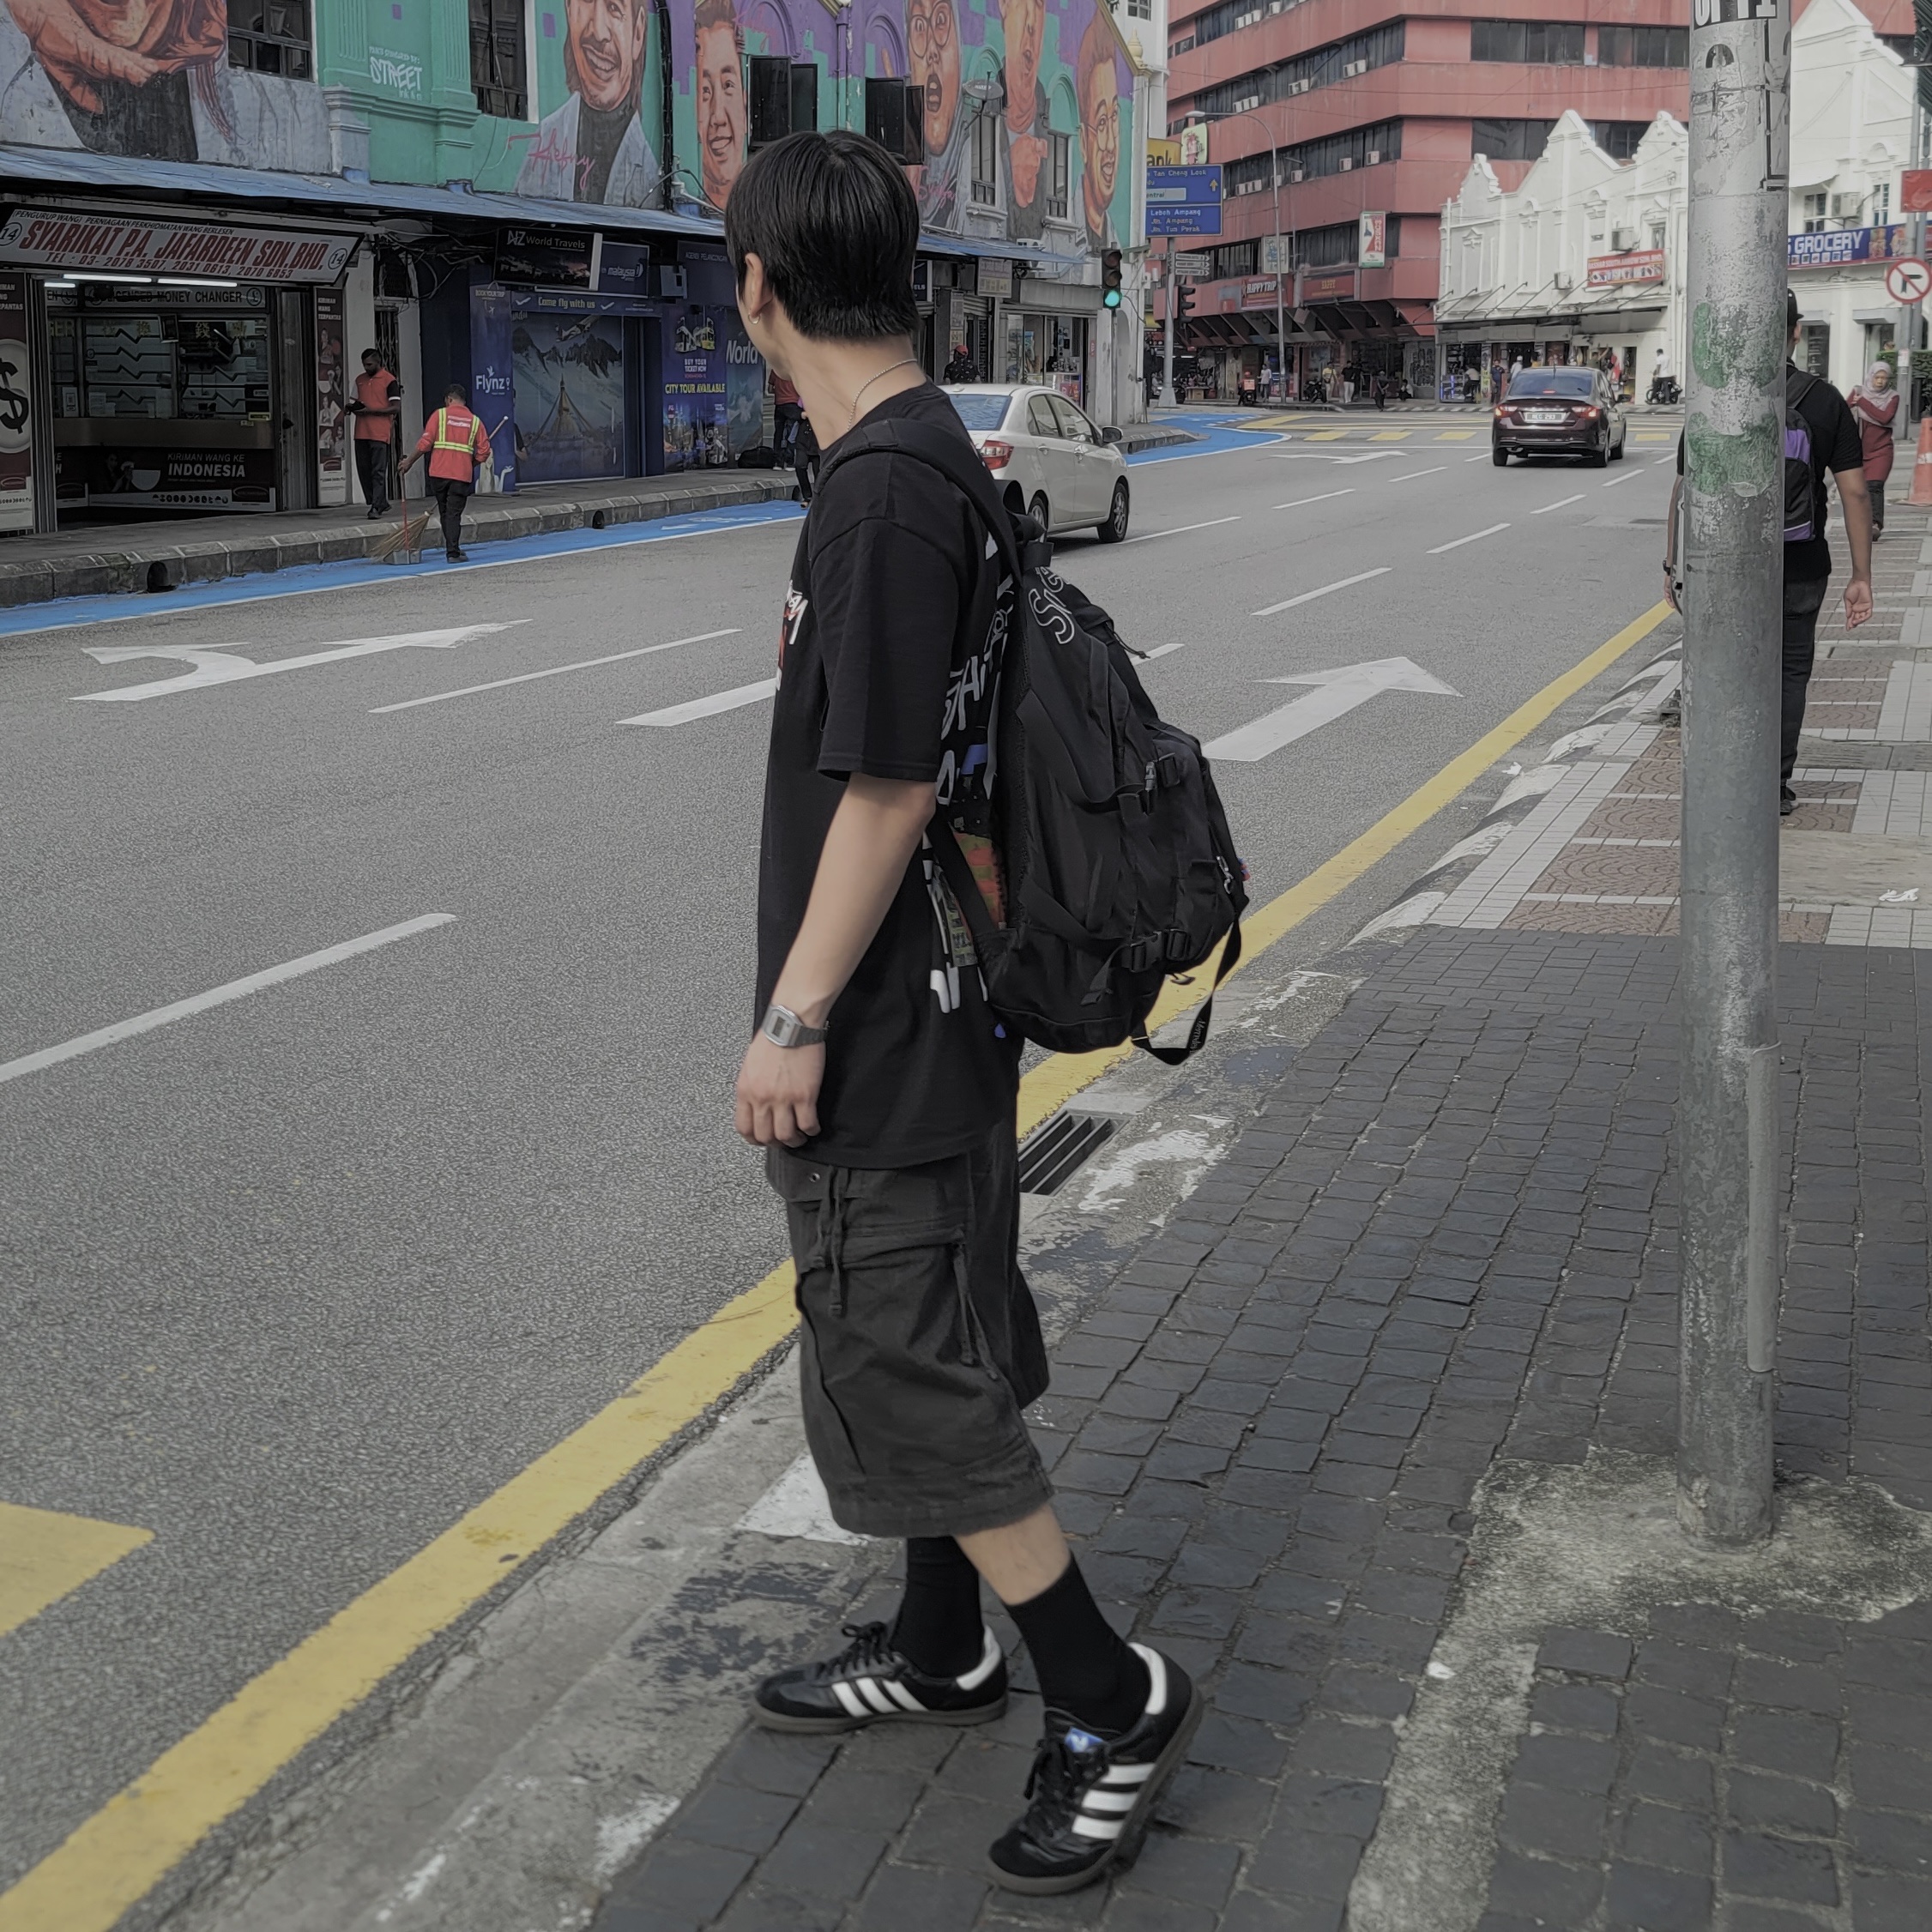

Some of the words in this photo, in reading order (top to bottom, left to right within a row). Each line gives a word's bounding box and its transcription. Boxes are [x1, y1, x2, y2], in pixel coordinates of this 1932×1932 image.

[370, 56, 423, 91] STREET
[1174, 208, 1201, 217] Ampang
[12, 210, 57, 223] (PENGURUP
[57, 214, 82, 224] WANG)
[85, 217, 132, 228] PERNIAGAAN
[131, 220, 184, 232] PERKHIDMATAN
[184, 225, 203, 233] WANG
[203, 226, 235, 236] BERLESEN
[0, 227, 19, 241] 14
[19, 220, 125, 256] SYARIKAT
[116, 228, 154, 258] P.A.
[154, 232, 259, 266] JAFARDEEN
[526, 235, 552, 246] World
[554, 238, 586, 249] Travels
[1794, 230, 1864, 255] GROCERY
[45, 251, 64, 263] TEL
[103, 257, 132, 269] 2078
[172, 261, 201, 272] 2031
[237, 266, 263, 277] 2070
[266, 269, 294, 279] 6853
[330, 252, 344, 265] 14
[195, 291, 242, 303] CHANGER
[538, 297, 557, 307] Come
[558, 298, 568, 309] fly
[569, 299, 586, 309] with
[587, 300, 595, 309] us
[665, 383, 679, 395] CITY
[679, 383, 696, 394] TOUR
[696, 383, 726, 394] AVAILABLE
[167, 452, 202, 462] KIRIMAN
[205, 453, 232, 462] WANG
[233, 454, 245, 463] KE
[167, 463, 246, 478] INDONESIA
